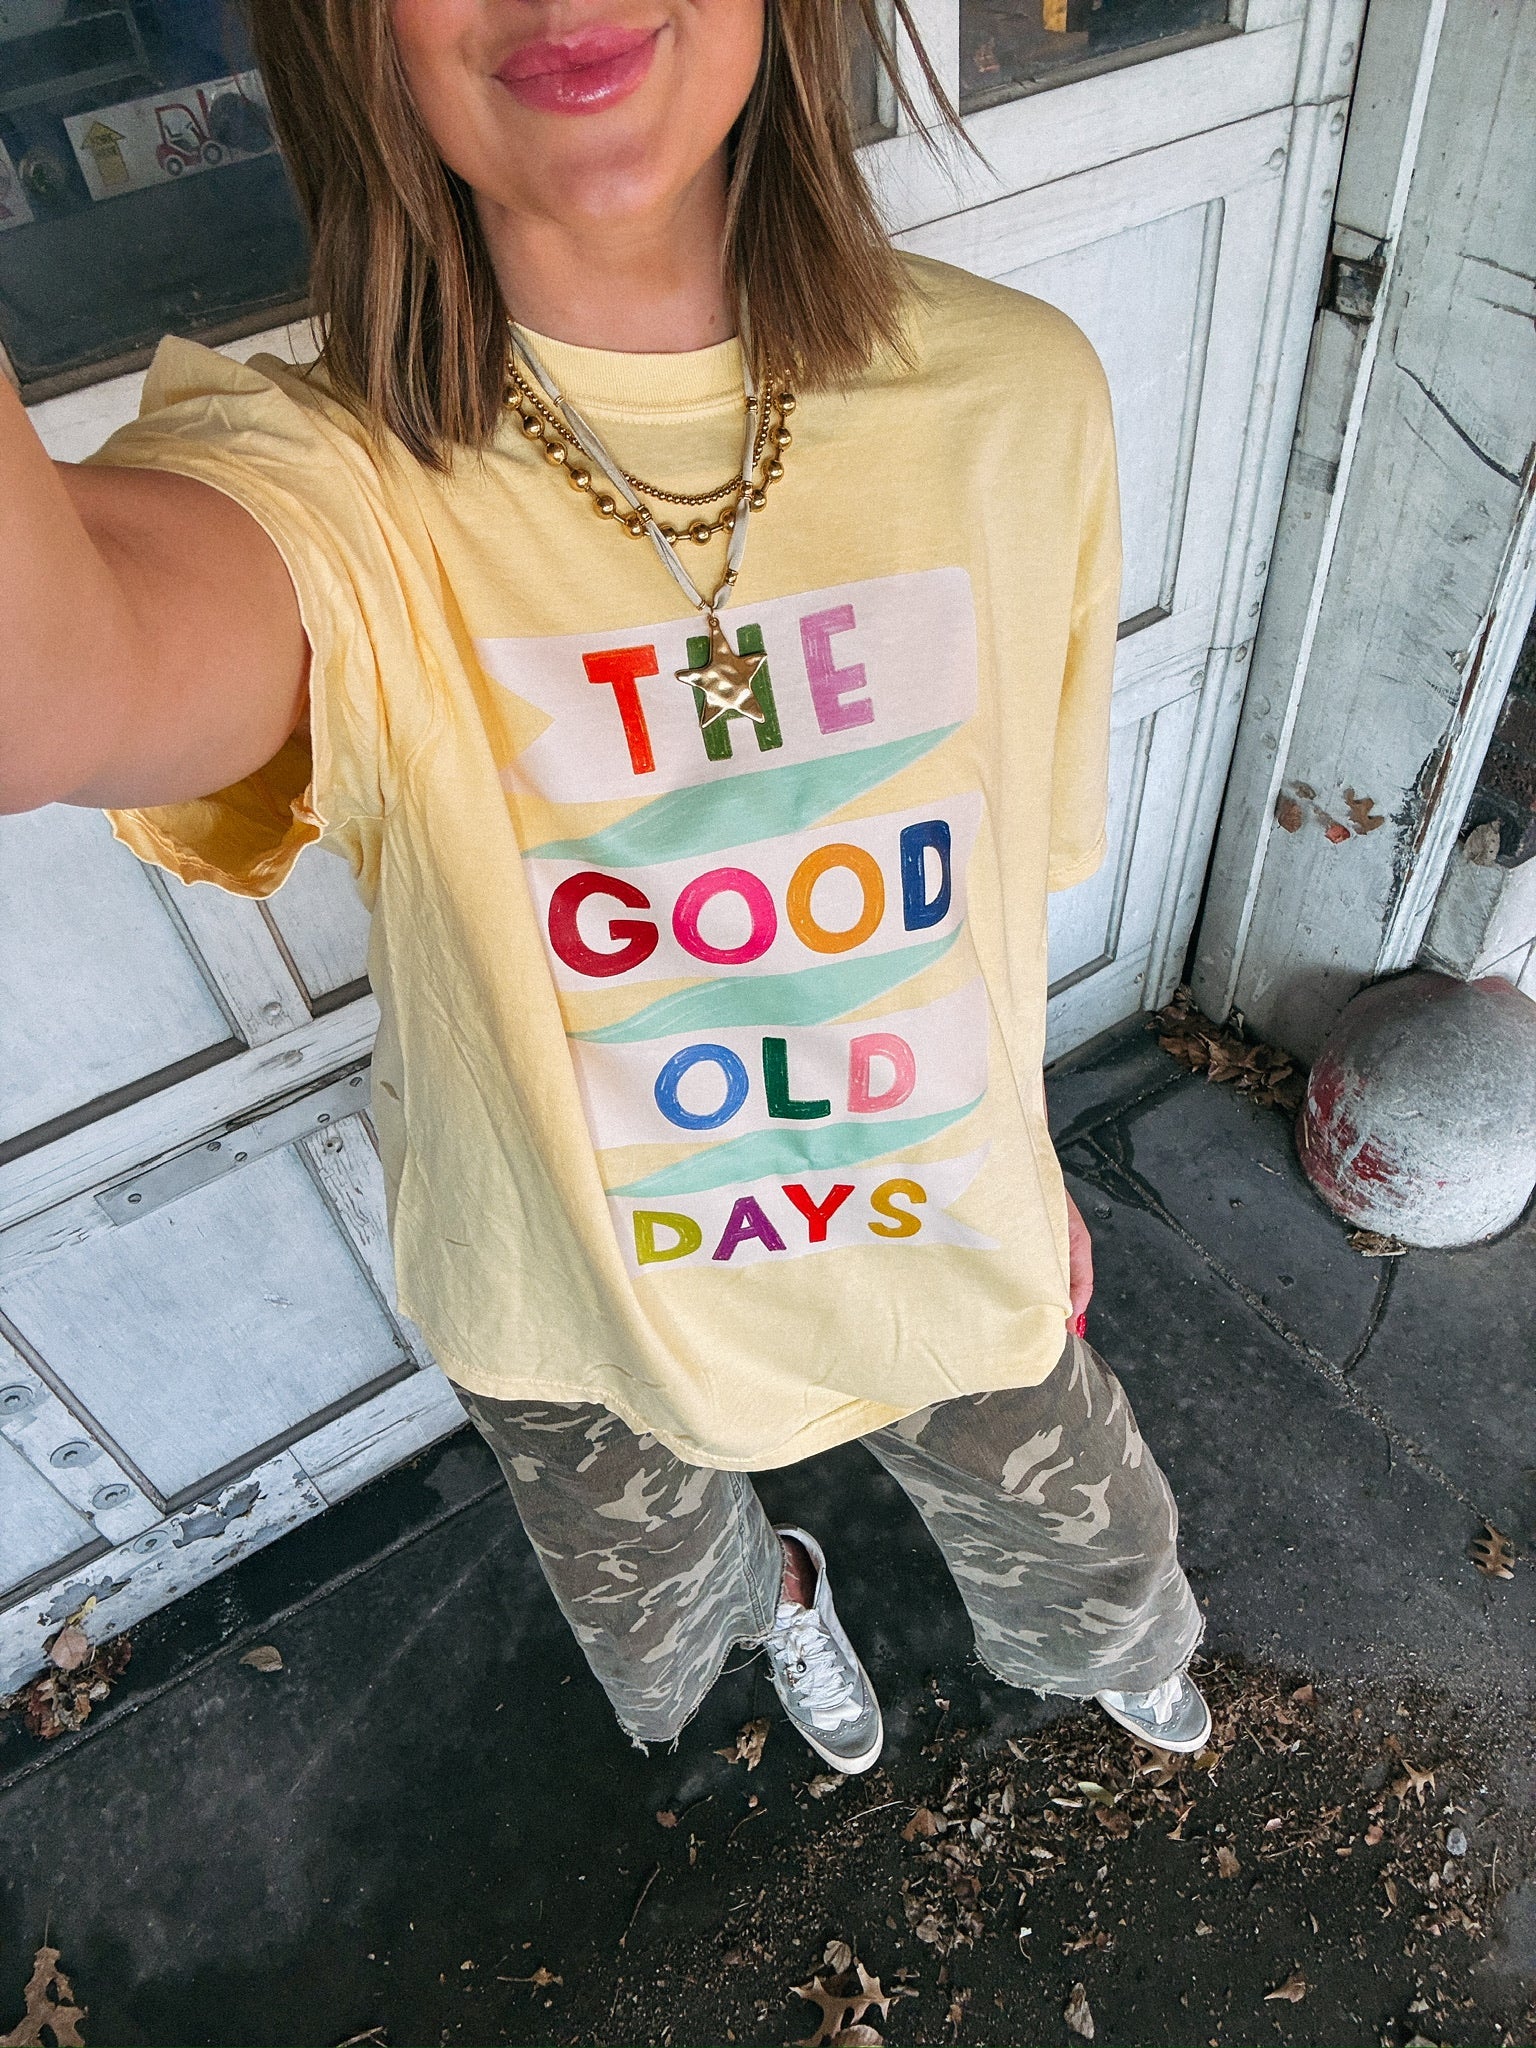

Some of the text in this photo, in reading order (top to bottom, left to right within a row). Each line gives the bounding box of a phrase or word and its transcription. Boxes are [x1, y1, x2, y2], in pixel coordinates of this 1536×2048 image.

[582, 604, 874, 774] THE
[548, 820, 950, 977] GOOD
[654, 1033, 916, 1130] OLD
[633, 1178, 927, 1265] DAYS
